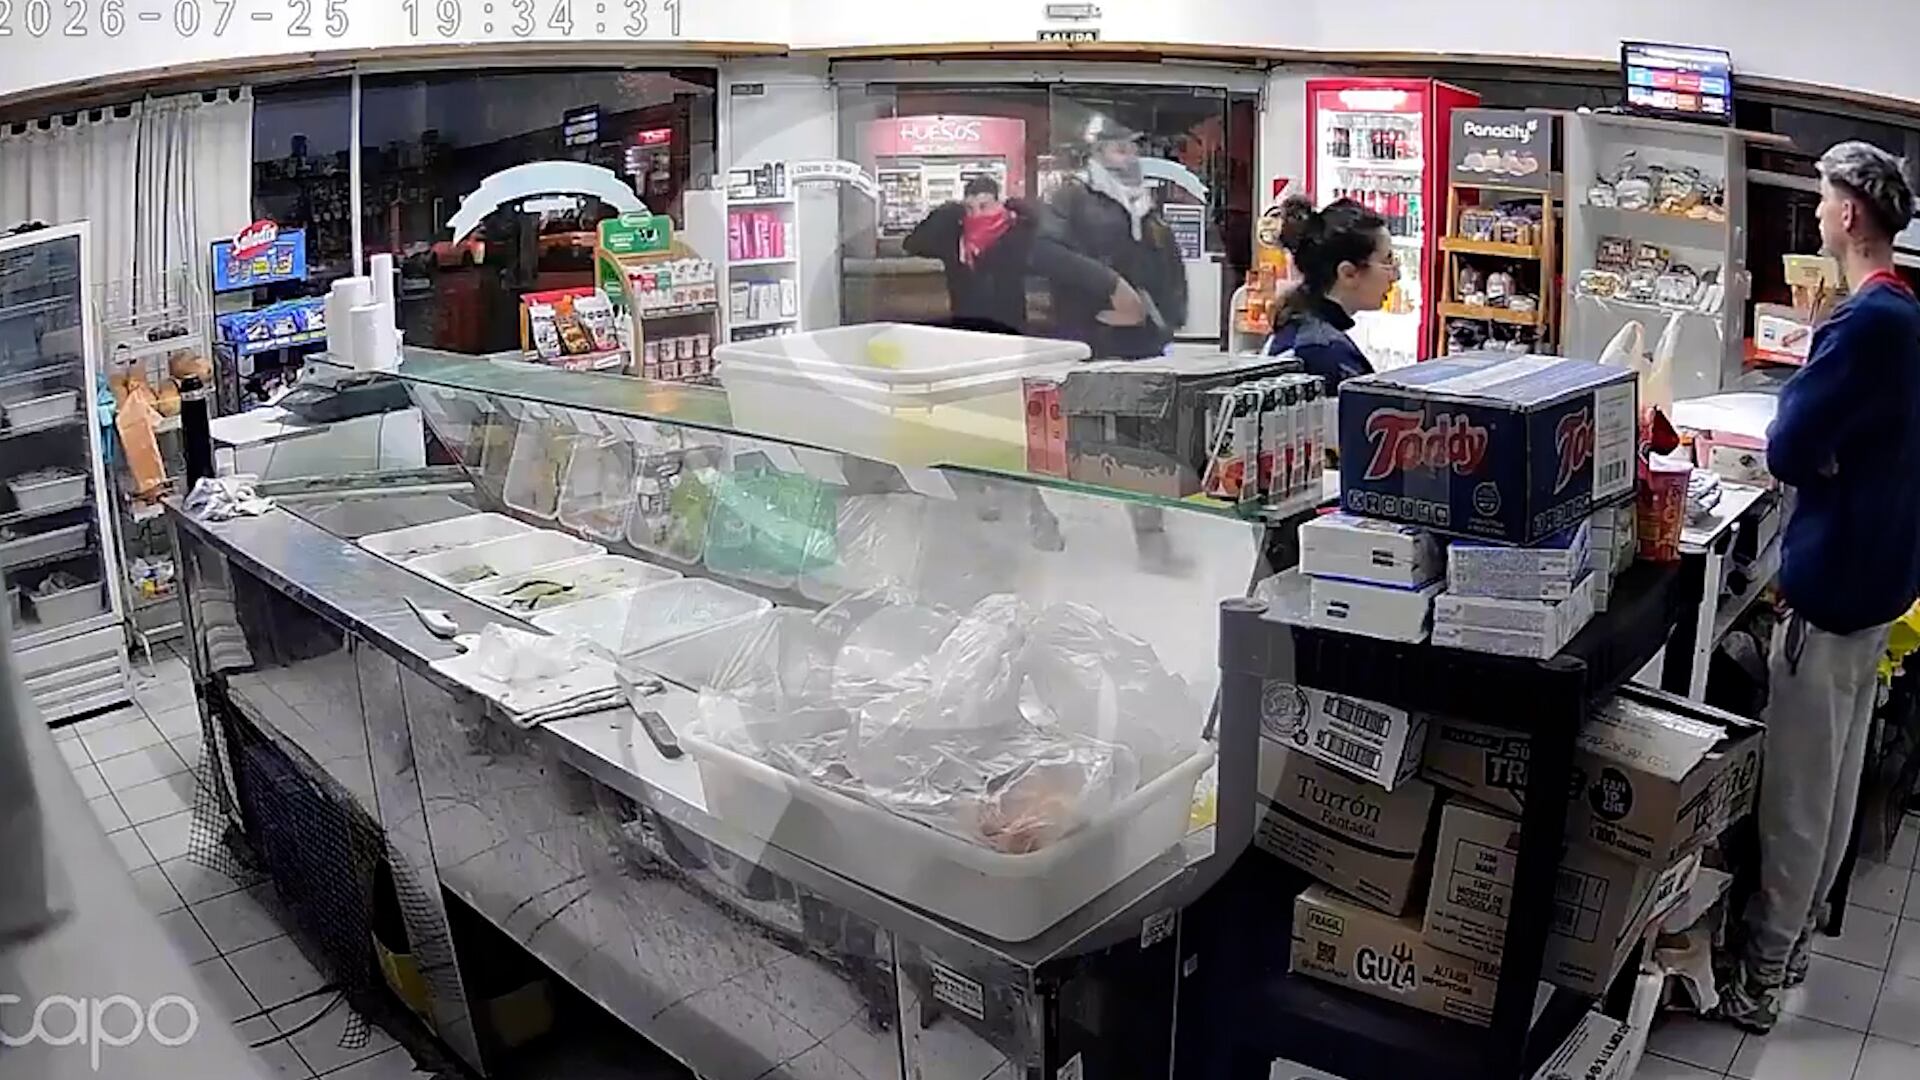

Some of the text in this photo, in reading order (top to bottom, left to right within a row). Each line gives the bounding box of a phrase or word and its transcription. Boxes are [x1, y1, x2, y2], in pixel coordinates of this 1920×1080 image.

[1040, 31, 1097, 42] SALIDA
[900, 121, 982, 141] HUESOS
[1463, 120, 1532, 144] Panacity
[1363, 407, 1489, 481] Toddy
[1297, 774, 1381, 823] Turrón
[1356, 948, 1416, 989] GULA
